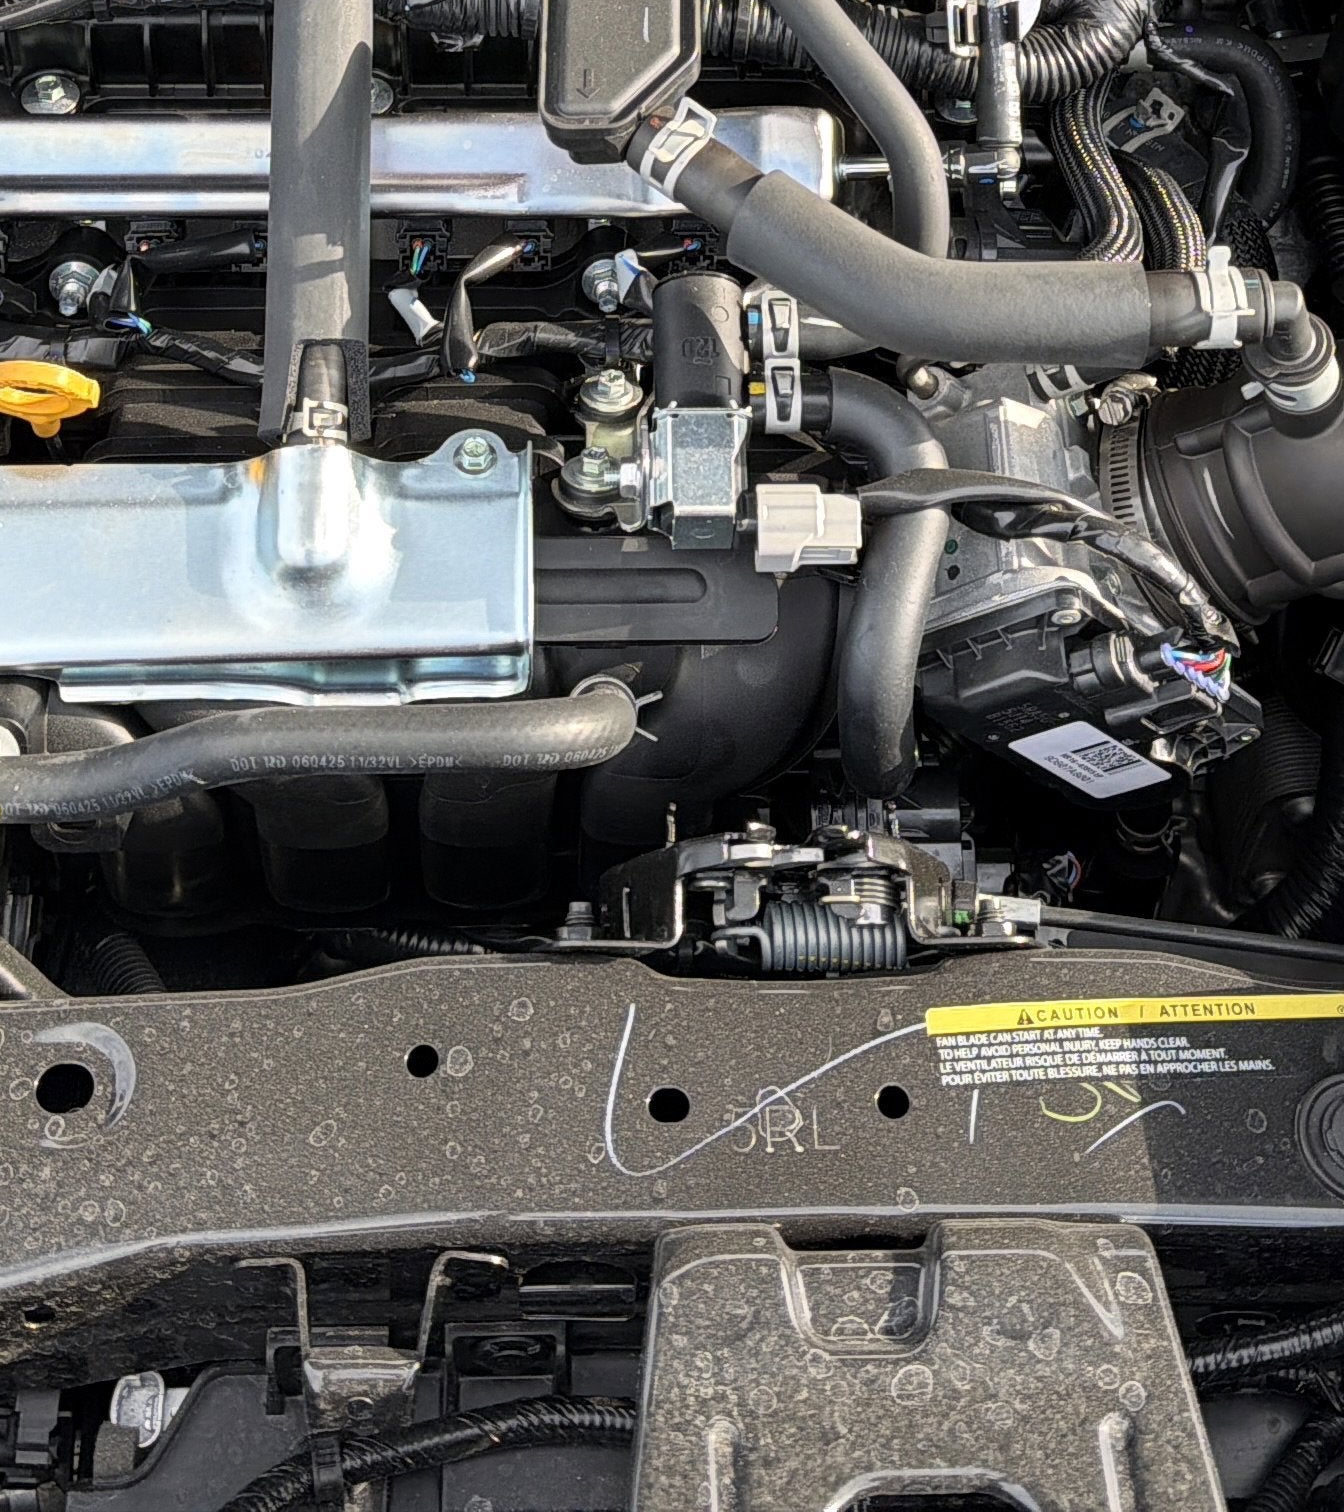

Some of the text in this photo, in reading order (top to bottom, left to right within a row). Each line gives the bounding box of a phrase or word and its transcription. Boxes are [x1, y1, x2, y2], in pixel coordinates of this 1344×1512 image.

[229, 756, 256, 771] DOT
[291, 755, 345, 768] 060425
[349, 755, 401, 768] 11/32VL
[408, 755, 463, 768] >EPDM<
[501, 752, 530, 767] DOT
[53, 798, 100, 815] 060425
[1036, 1006, 1119, 1023] CAUTION
[1159, 1002, 1256, 1018] ATTENTION
[936, 1036, 956, 1048] FAN
[957, 1034, 989, 1046] BLADE
[990, 1033, 1011, 1045] CAN
[1012, 1030, 1042, 1042] START
[1043, 1029, 1055, 1040] AT
[1055, 1028, 1079, 1039] ANY
[938, 1048, 954, 1060] TO
[955, 1047, 978, 1059] HELP
[980, 1045, 1011, 1057] AVOID
[1012, 1042, 1063, 1055] PERSONAL
[1099, 1039, 1122, 1050] KEEP
[1123, 1038, 1157, 1049] HANDS
[1158, 1037, 1190, 1048] CLEAR.
[940, 1047, 1229, 1073] LE VENTILATEUR RISQUE DE DÉMARRER À TOUT MOMENT.
[941, 1059, 1276, 1086] POUR ÉVITER TOUTE BLESSURE, NE PAS EN APPROCHER LES MAINS.
